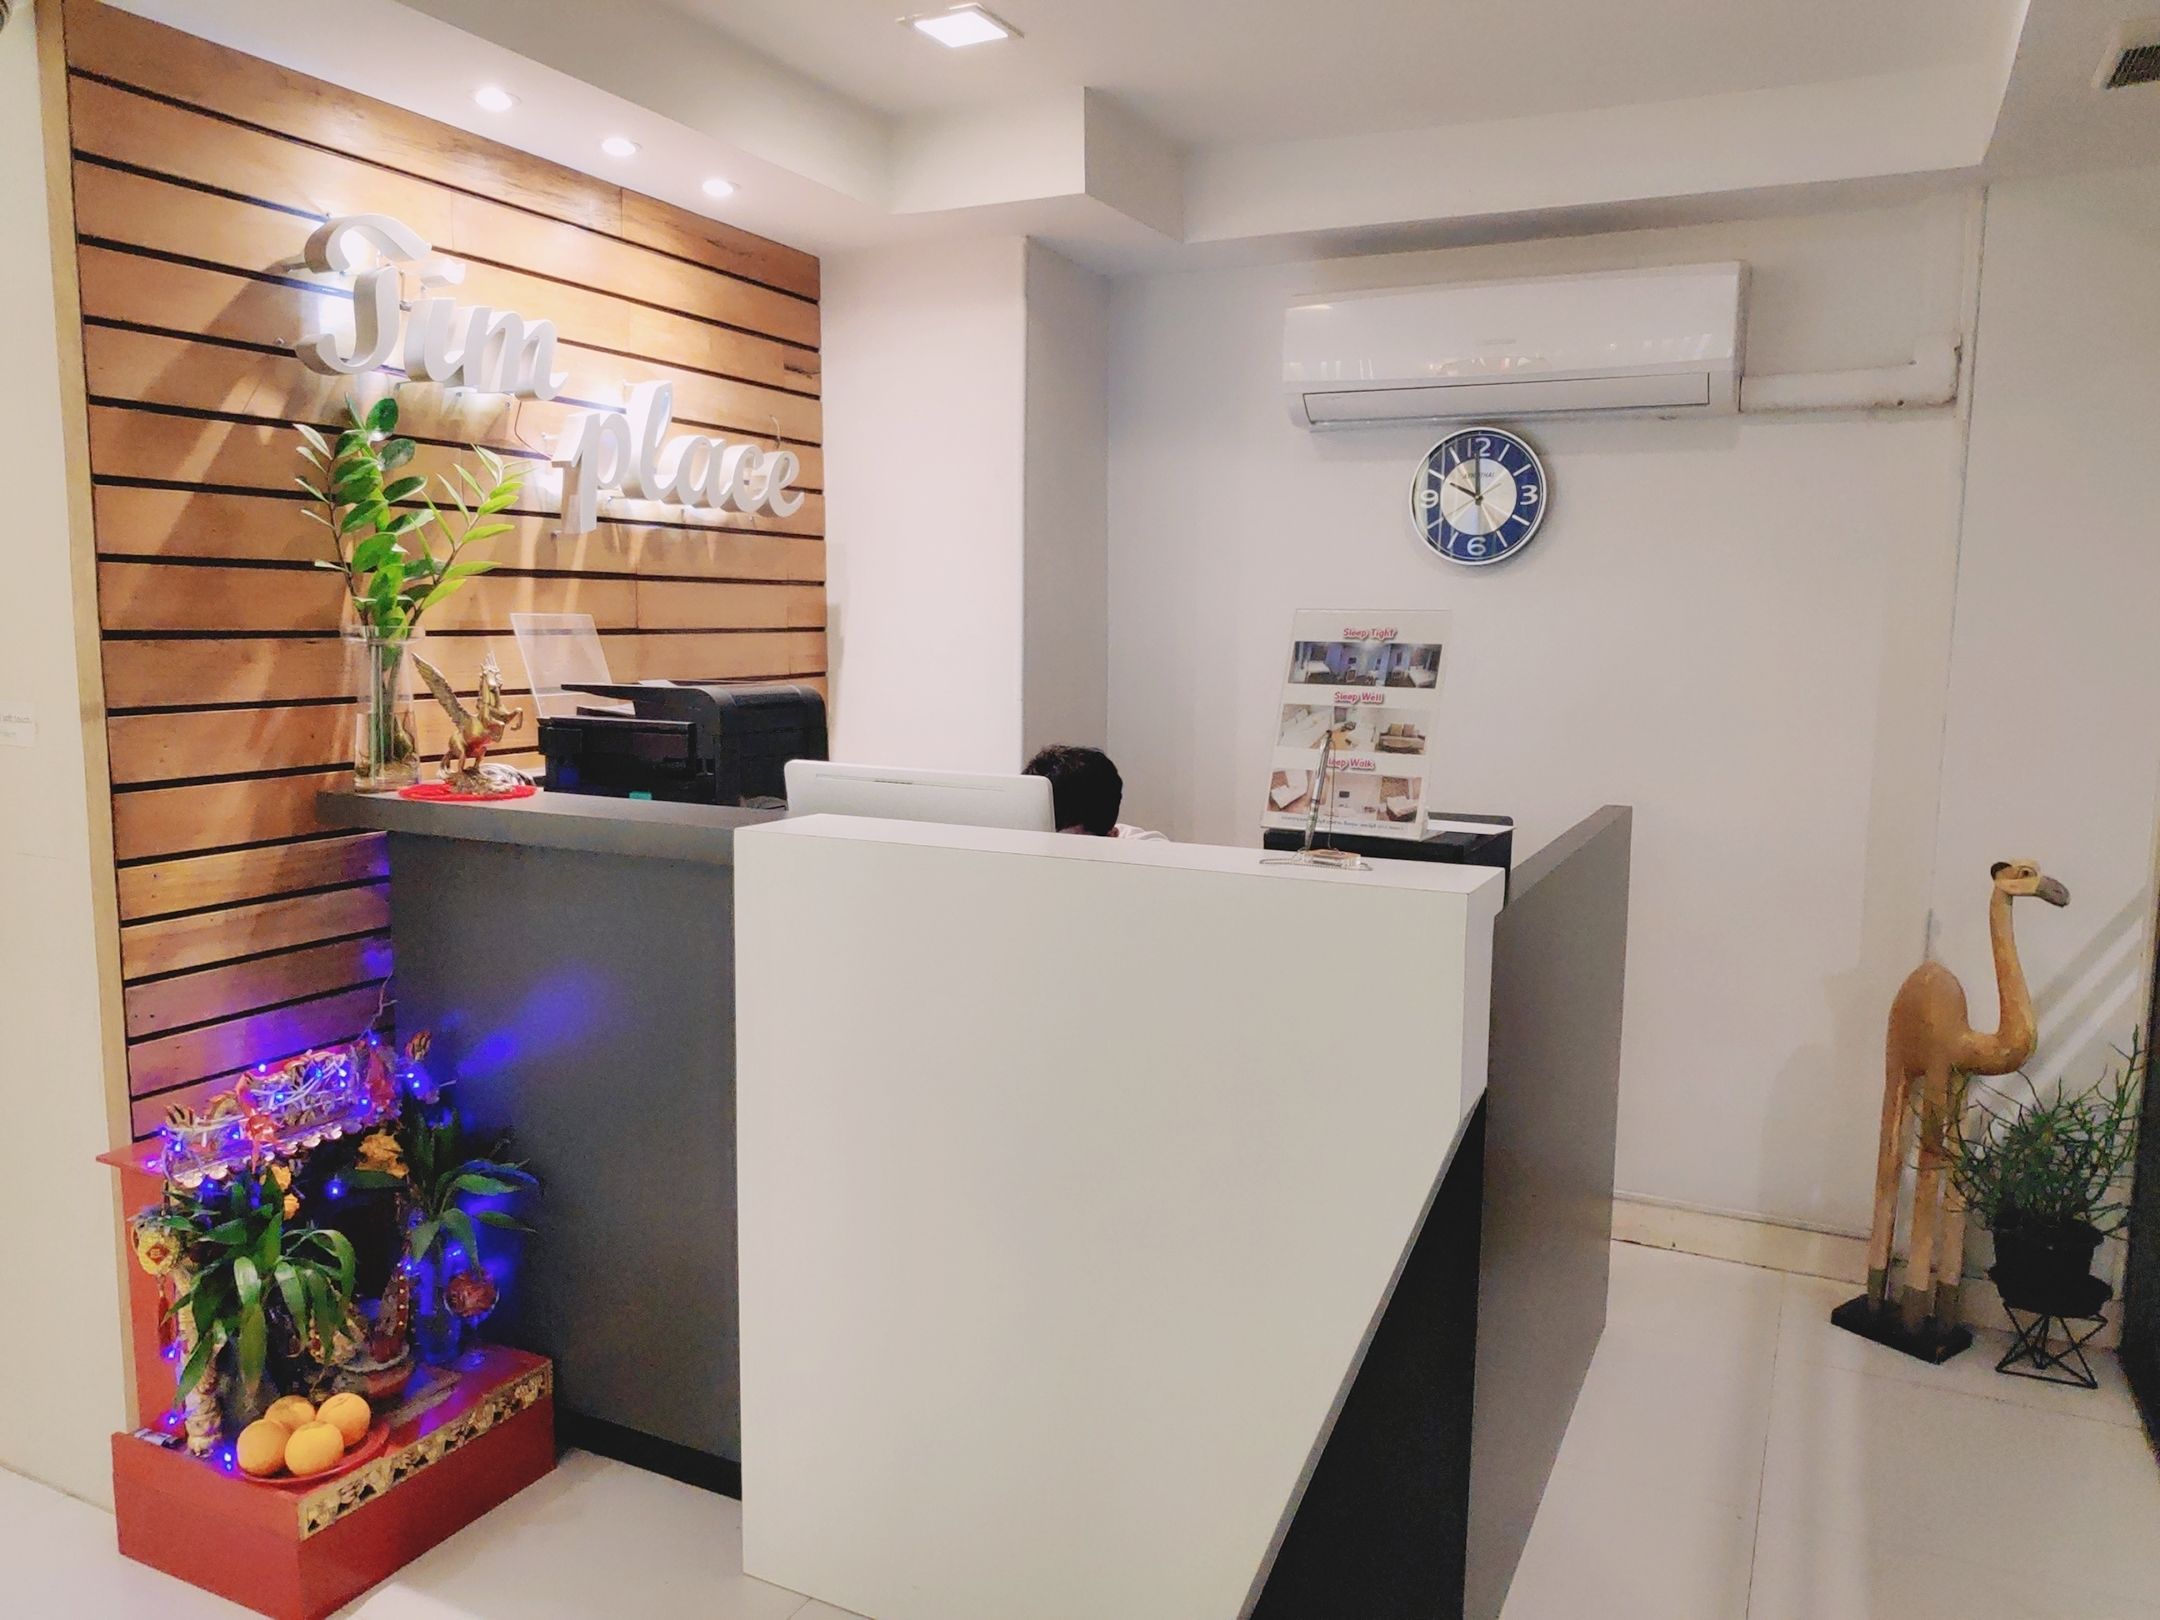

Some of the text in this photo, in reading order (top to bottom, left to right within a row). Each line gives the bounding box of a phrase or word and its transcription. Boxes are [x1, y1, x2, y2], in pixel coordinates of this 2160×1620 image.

[551, 380, 804, 534] place
[1467, 437, 1492, 458] 12
[1420, 489, 1439, 509] 9
[1520, 485, 1539, 505] 3
[1467, 537, 1487, 556] 6
[1343, 628, 1395, 640] Sleep Tight
[1334, 691, 1383, 703] Sleep Well
